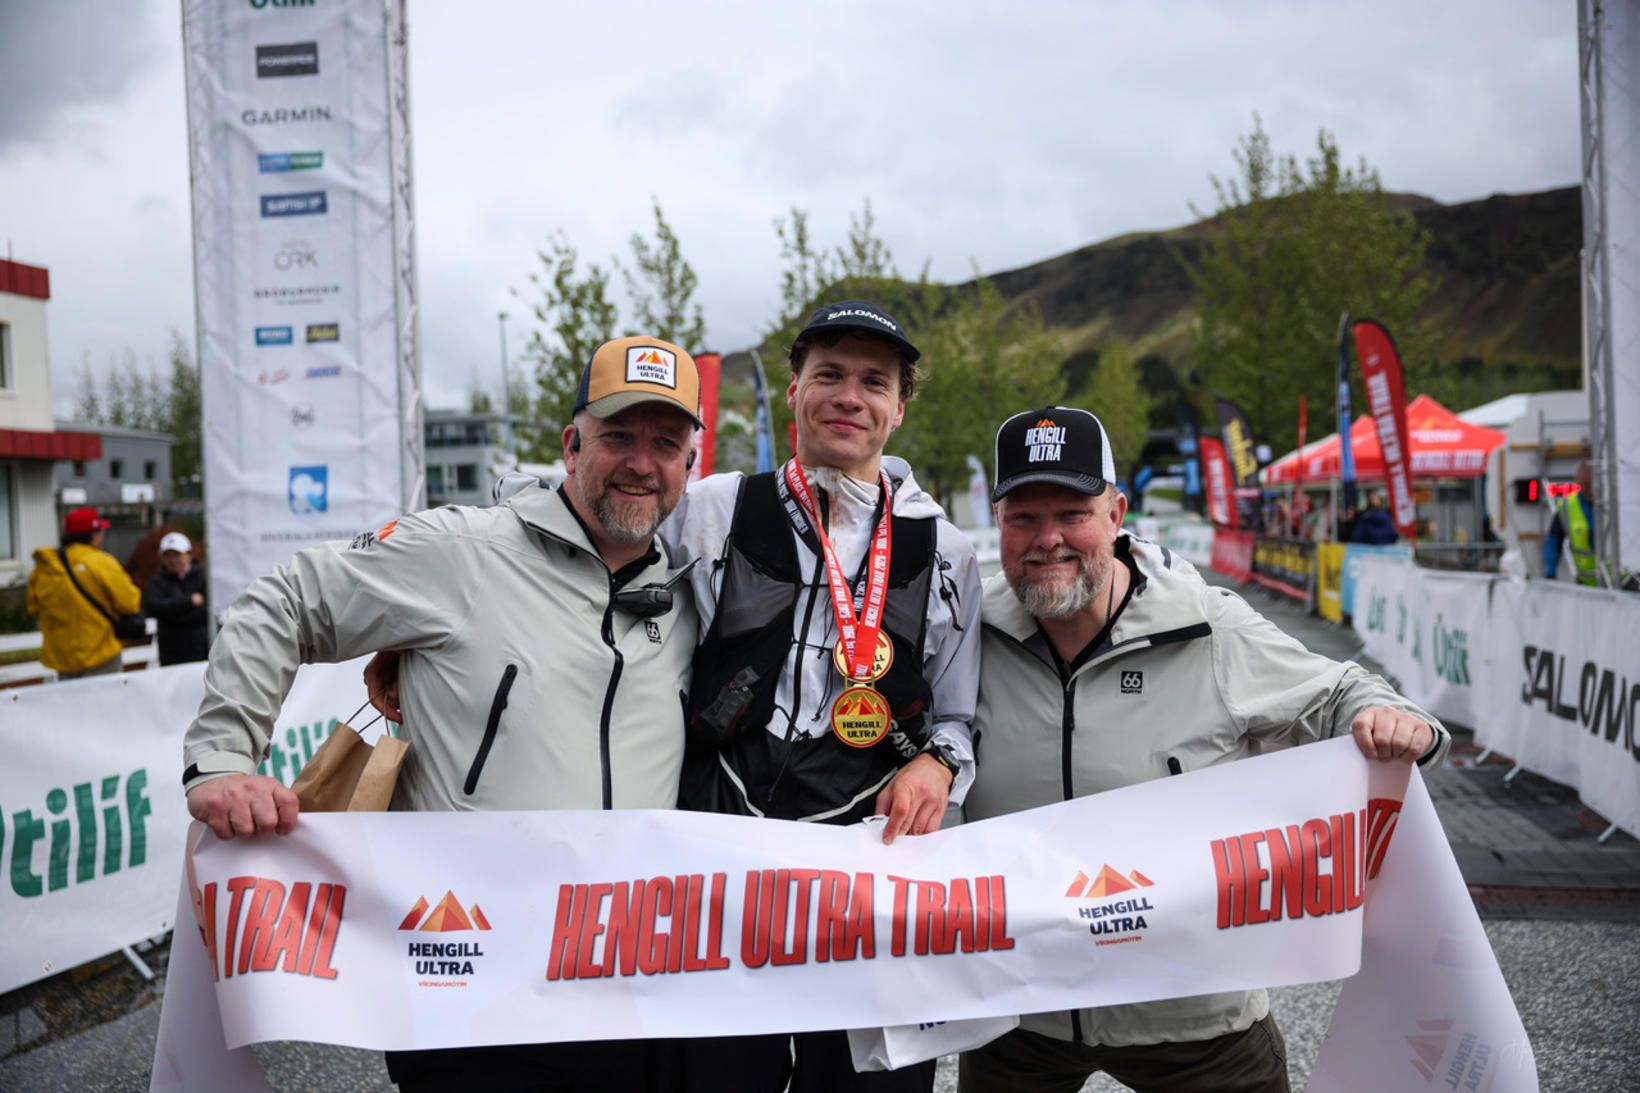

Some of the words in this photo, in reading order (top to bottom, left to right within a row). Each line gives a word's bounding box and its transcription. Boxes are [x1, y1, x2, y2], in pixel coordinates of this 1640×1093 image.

[241, 106, 332, 126] GARMIN
[827, 309, 896, 331] SALOMON
[636, 364, 669, 375] HENGILL
[640, 371, 665, 381] ULTRA
[1025, 426, 1066, 446] HENGILL
[1028, 444, 1061, 463] ULTRA
[1123, 673, 1141, 688] 66
[842, 720, 882, 729] HENGILL
[847, 730, 878, 738] ULTRA
[0, 768, 152, 898] tilíf
[1078, 897, 1154, 919] HENGILL
[225, 875, 347, 980] TRAIL
[546, 872, 729, 981] HENGILL
[740, 868, 876, 969] ULTRA
[887, 873, 1015, 957] TRAIL
[1089, 915, 1148, 935] ULTRA
[408, 942, 484, 957] HENGILL
[415, 960, 474, 975] ULTRA
